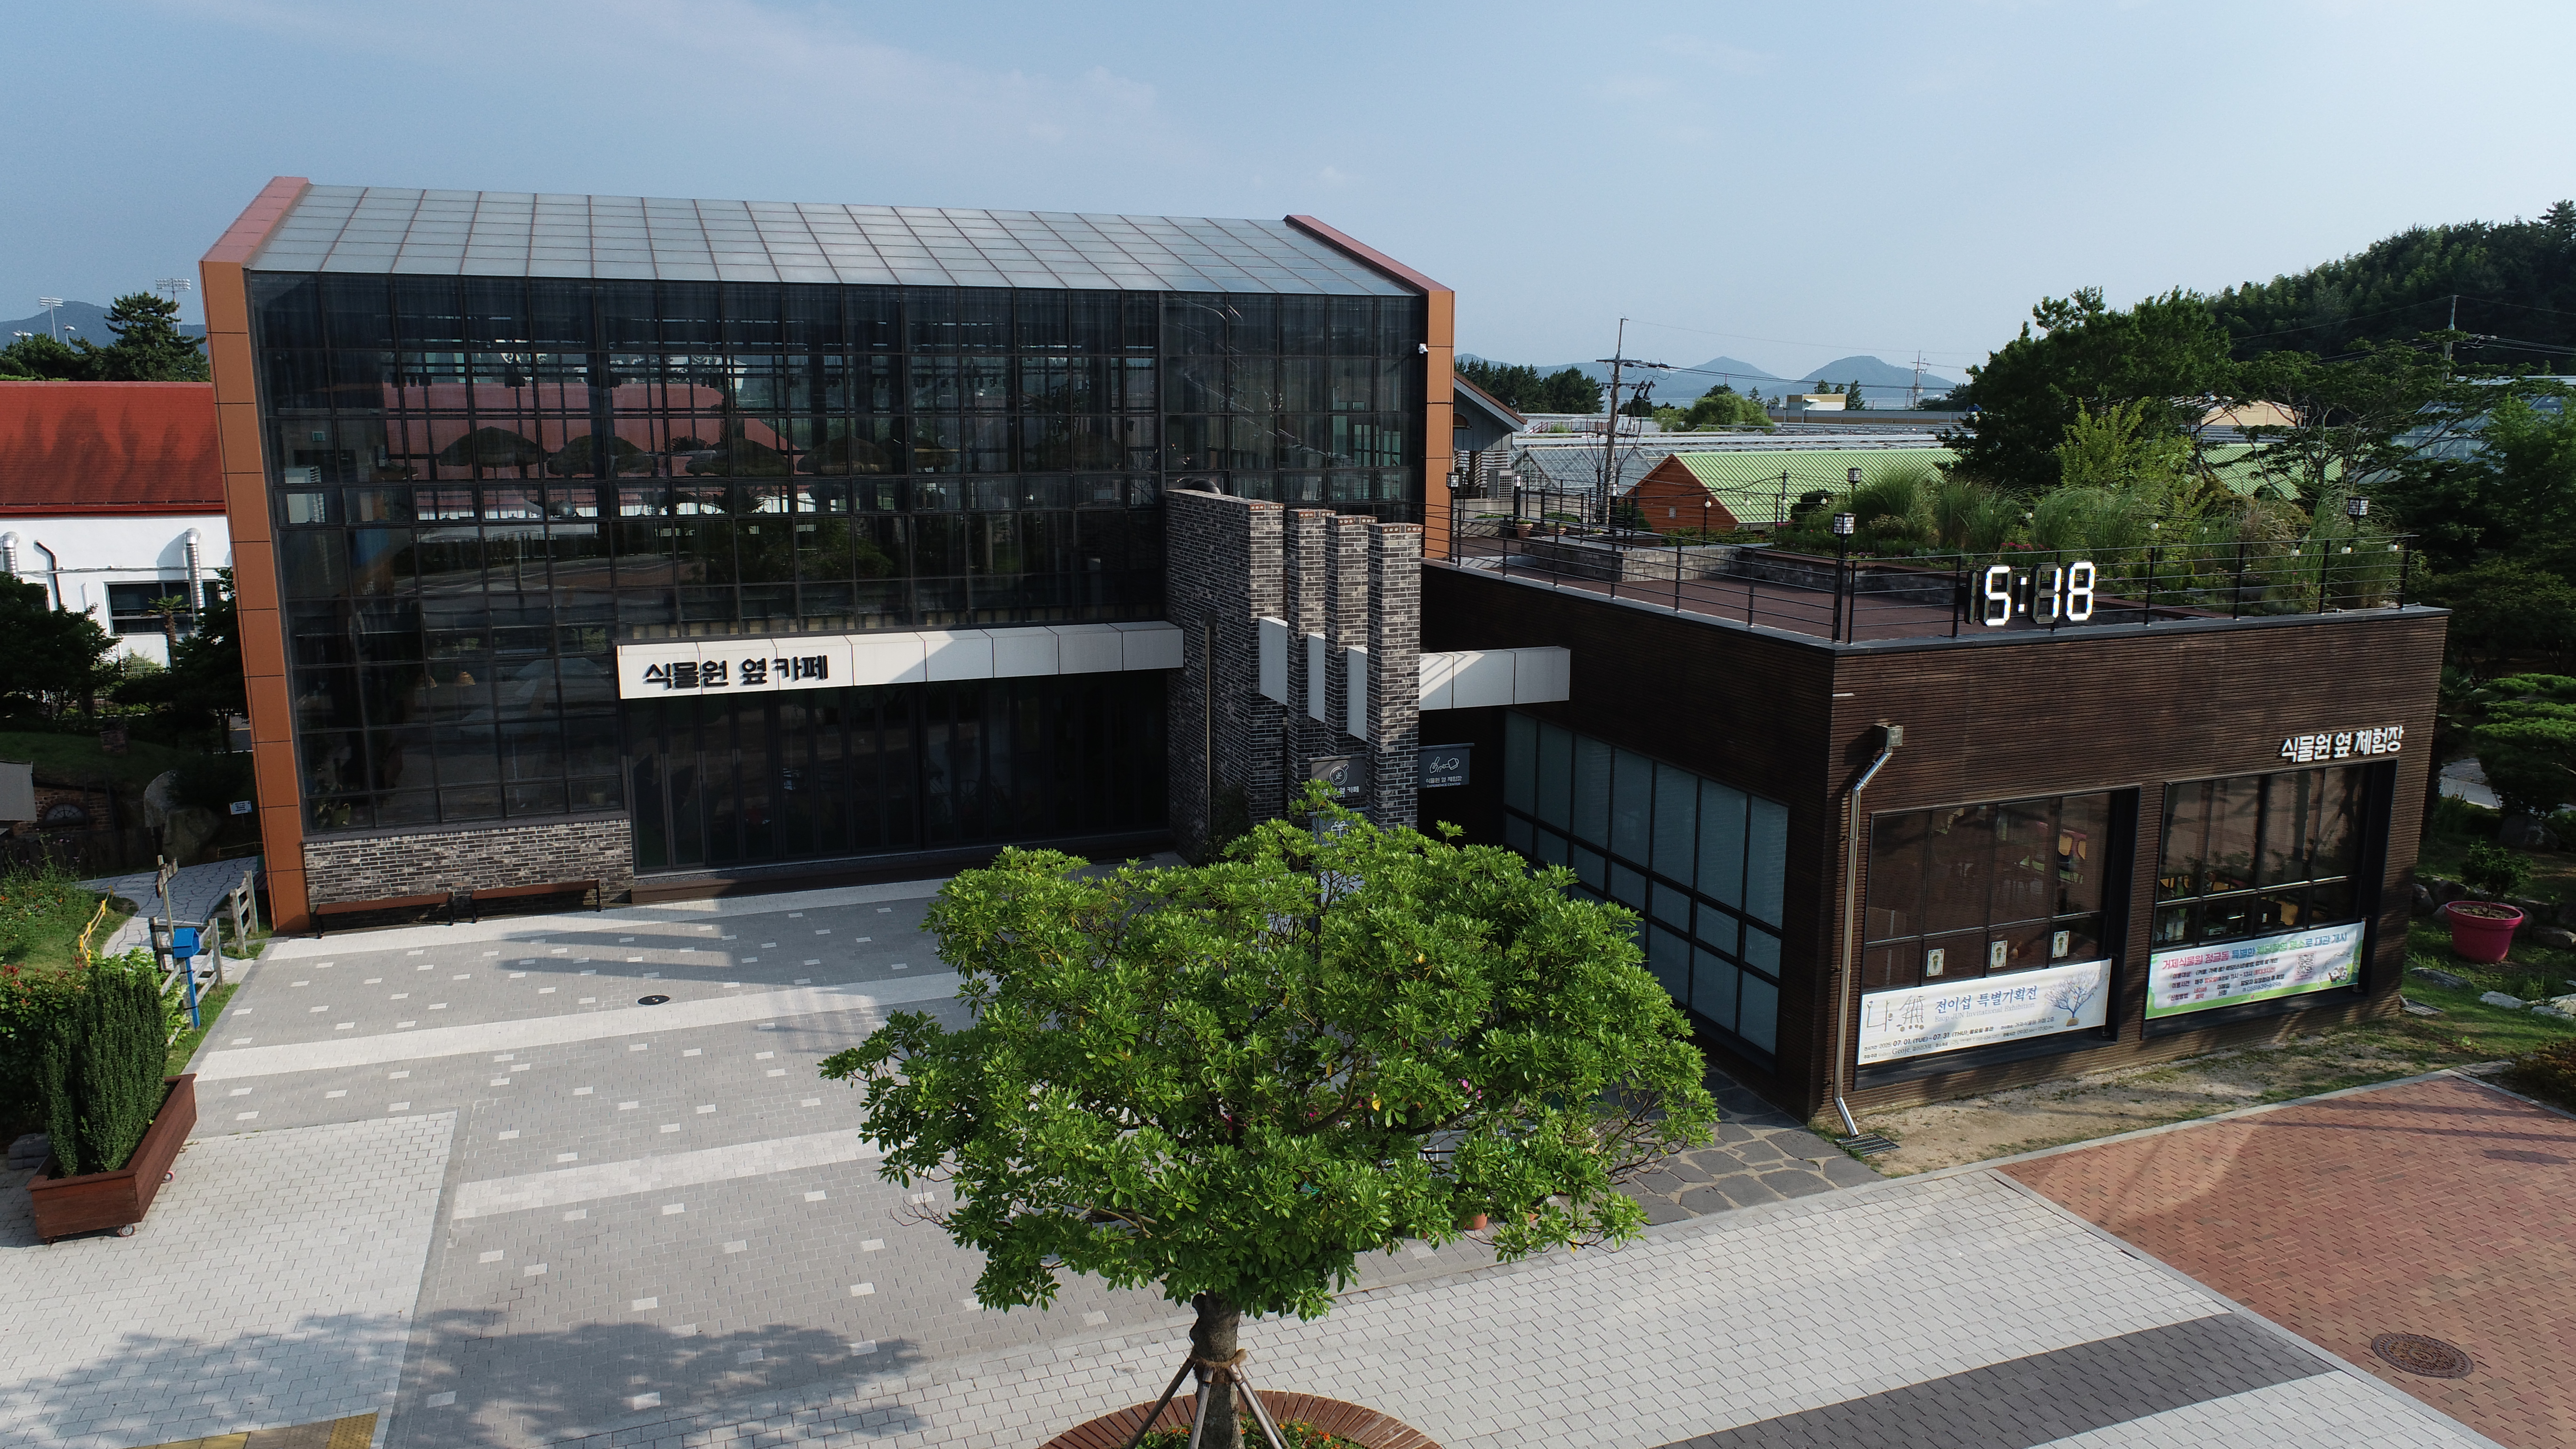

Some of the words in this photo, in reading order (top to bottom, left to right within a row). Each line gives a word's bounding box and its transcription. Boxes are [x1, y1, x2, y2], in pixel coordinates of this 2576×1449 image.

[1983, 560, 2097, 628] 5:18
[644, 660, 729, 689] 식물원
[741, 658, 768, 685] 옆
[774, 654, 829, 681] 카페
[2281, 733, 2332, 763] 식물원
[2334, 732, 2352, 758] 옆
[2354, 725, 2405, 755] 체험장
[1347, 786, 1360, 794] 카페
[2162, 954, 2204, 970] 거제식물원
[2205, 950, 2230, 964] 정글돔
[2232, 947, 2256, 959] 특별한
[2314, 935, 2331, 946] 대관
[2331, 932, 2347, 943] 개시
[1934, 994, 1972, 1014] 전이섭
[1977, 985, 2038, 1007] 특별기획전
[1966, 1006, 2002, 1017] Invitational
[2004, 1002, 2035, 1012] Exhibition
